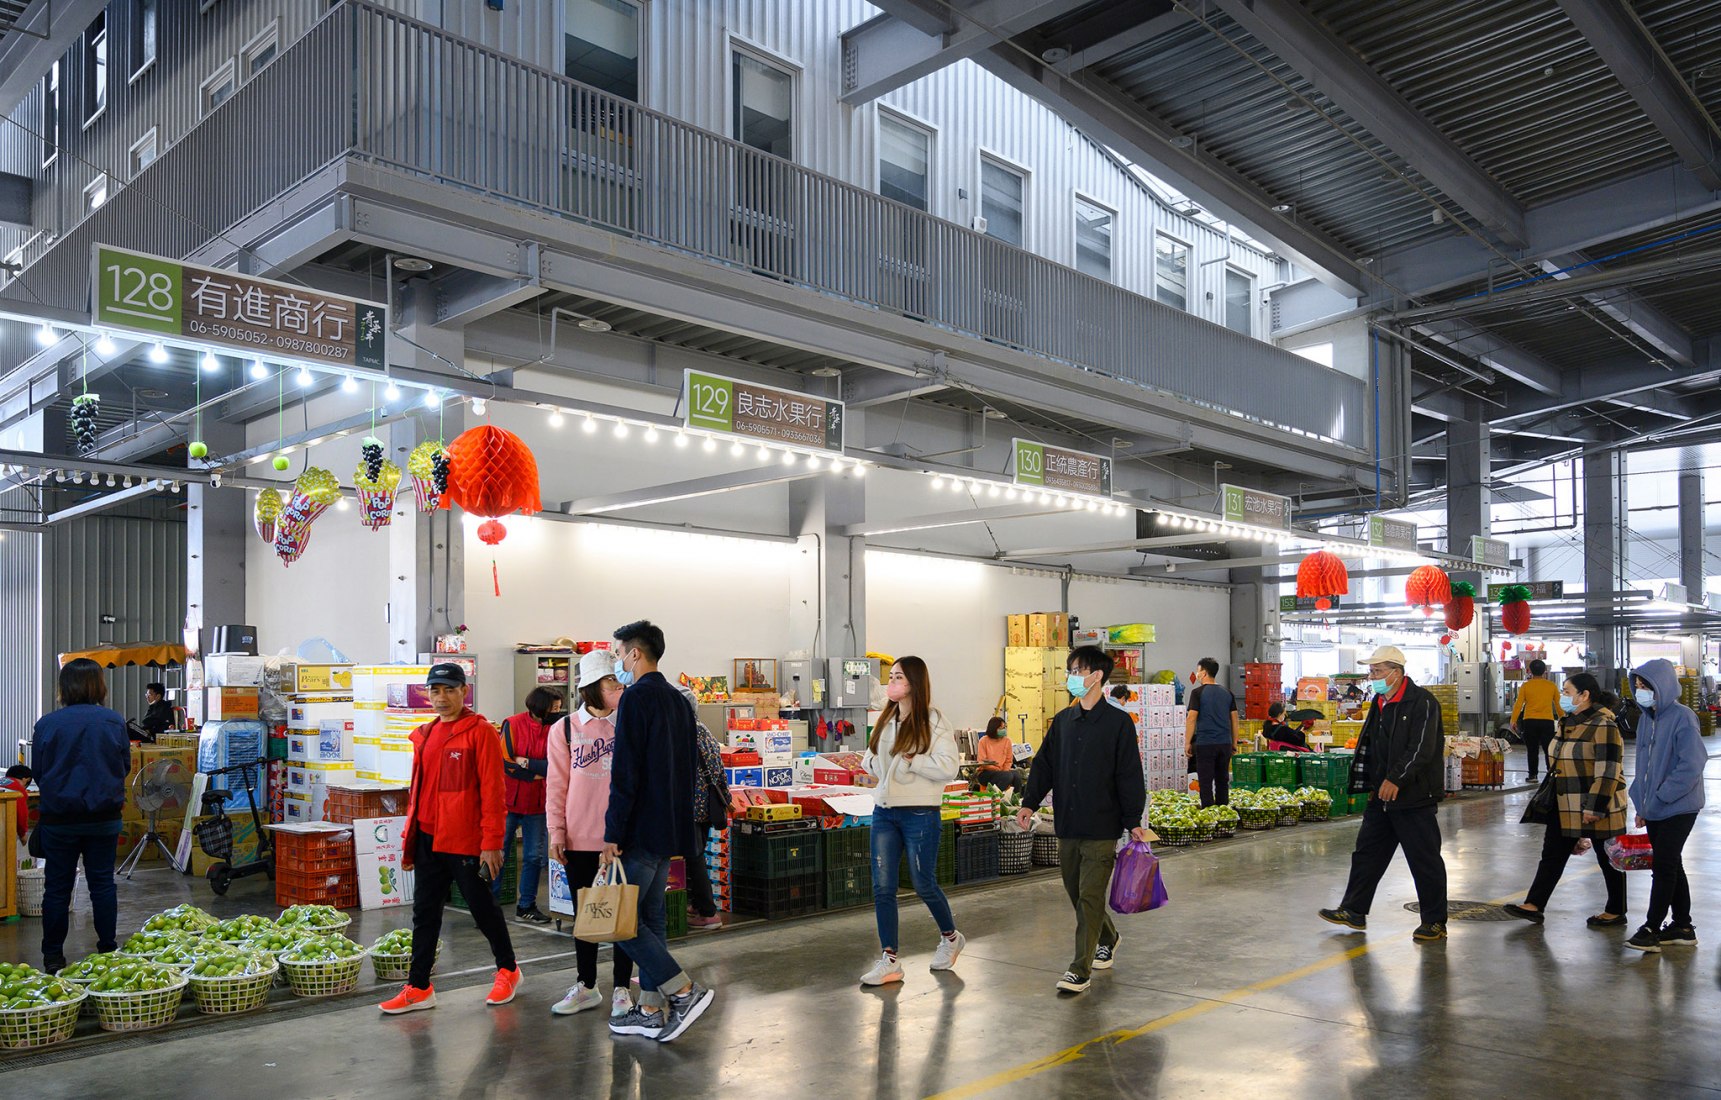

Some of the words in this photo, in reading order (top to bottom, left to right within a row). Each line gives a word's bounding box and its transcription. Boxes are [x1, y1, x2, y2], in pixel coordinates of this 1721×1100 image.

[106, 264, 174, 312] 128
[190, 276, 349, 341] 有進商行
[693, 383, 729, 415] 129
[738, 391, 822, 429] 良志水果行
[1018, 449, 1041, 473] 130
[1226, 492, 1242, 512] 131
[573, 745, 598, 768] Hush
